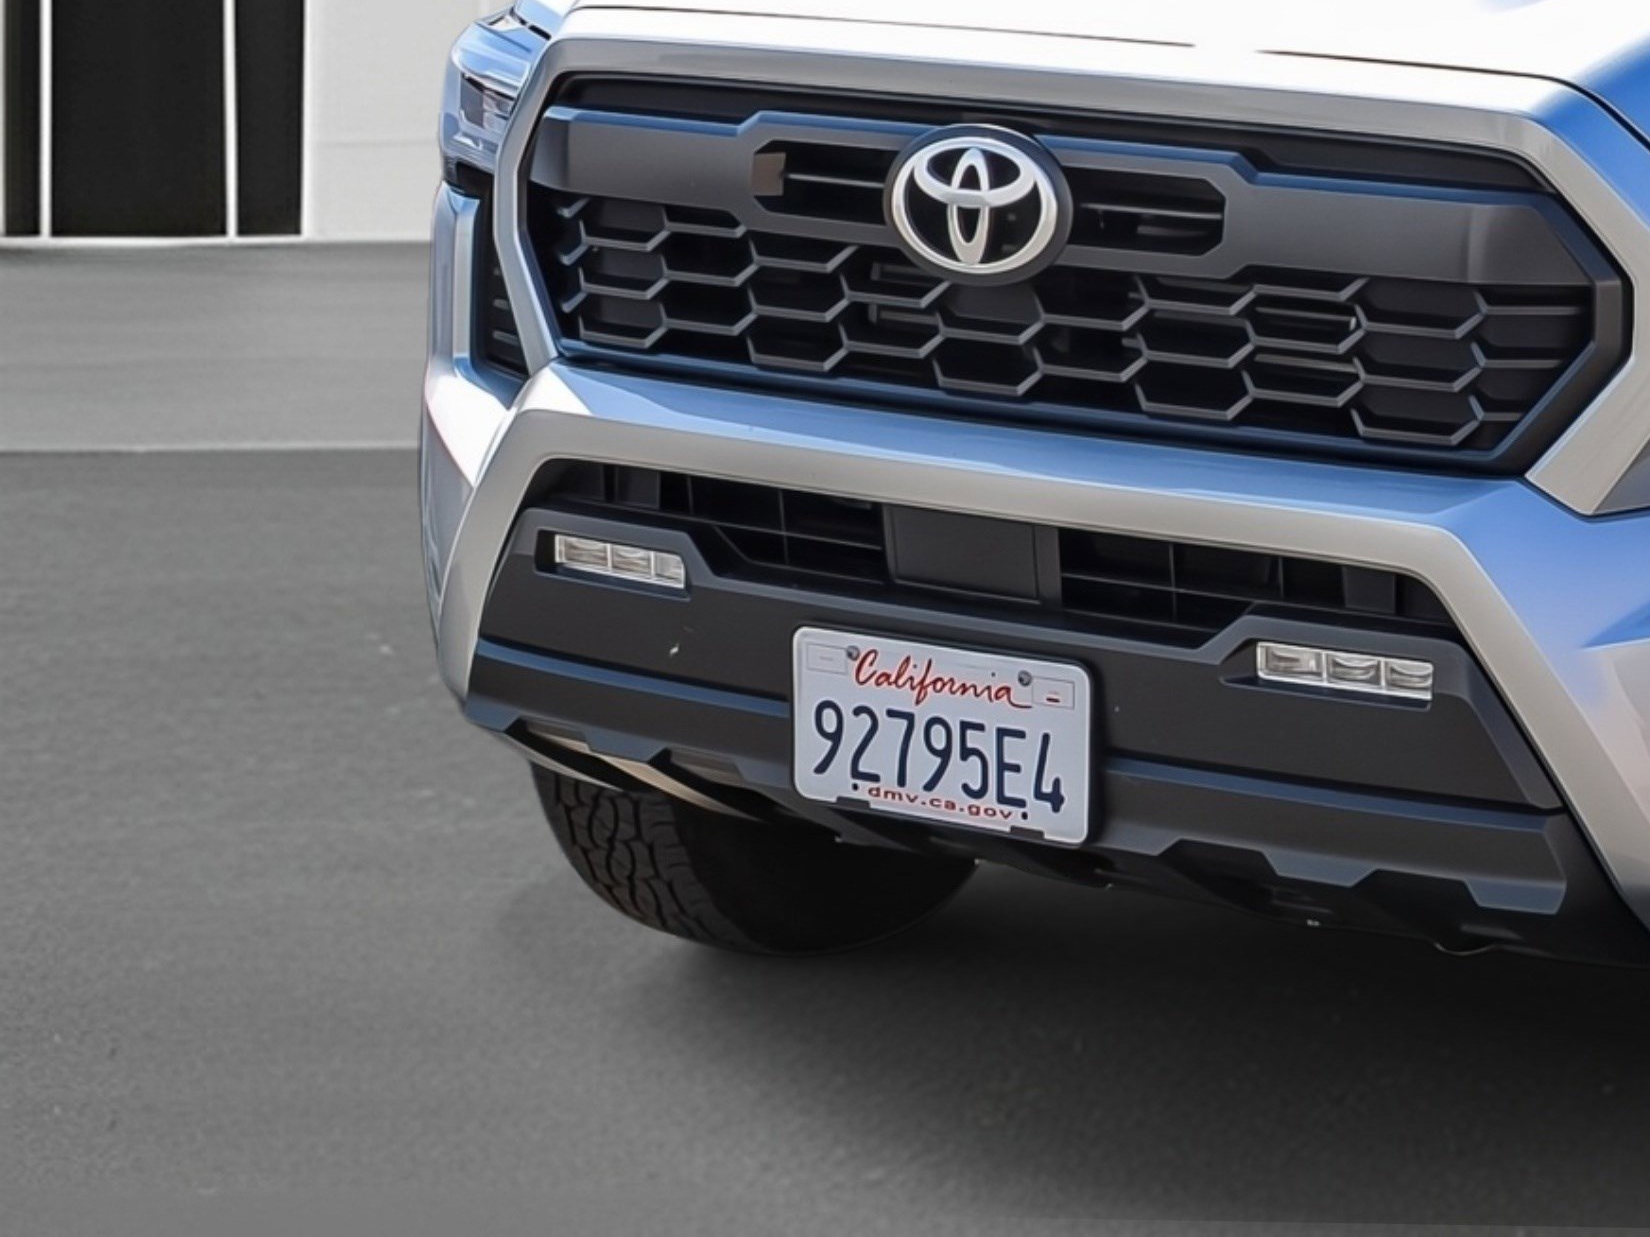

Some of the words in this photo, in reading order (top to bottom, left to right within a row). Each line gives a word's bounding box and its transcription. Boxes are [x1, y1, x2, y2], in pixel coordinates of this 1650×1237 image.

[854, 649, 1033, 709] California
[813, 699, 1066, 814] 92795E4
[868, 785, 1014, 820] dmv.ca.gov
